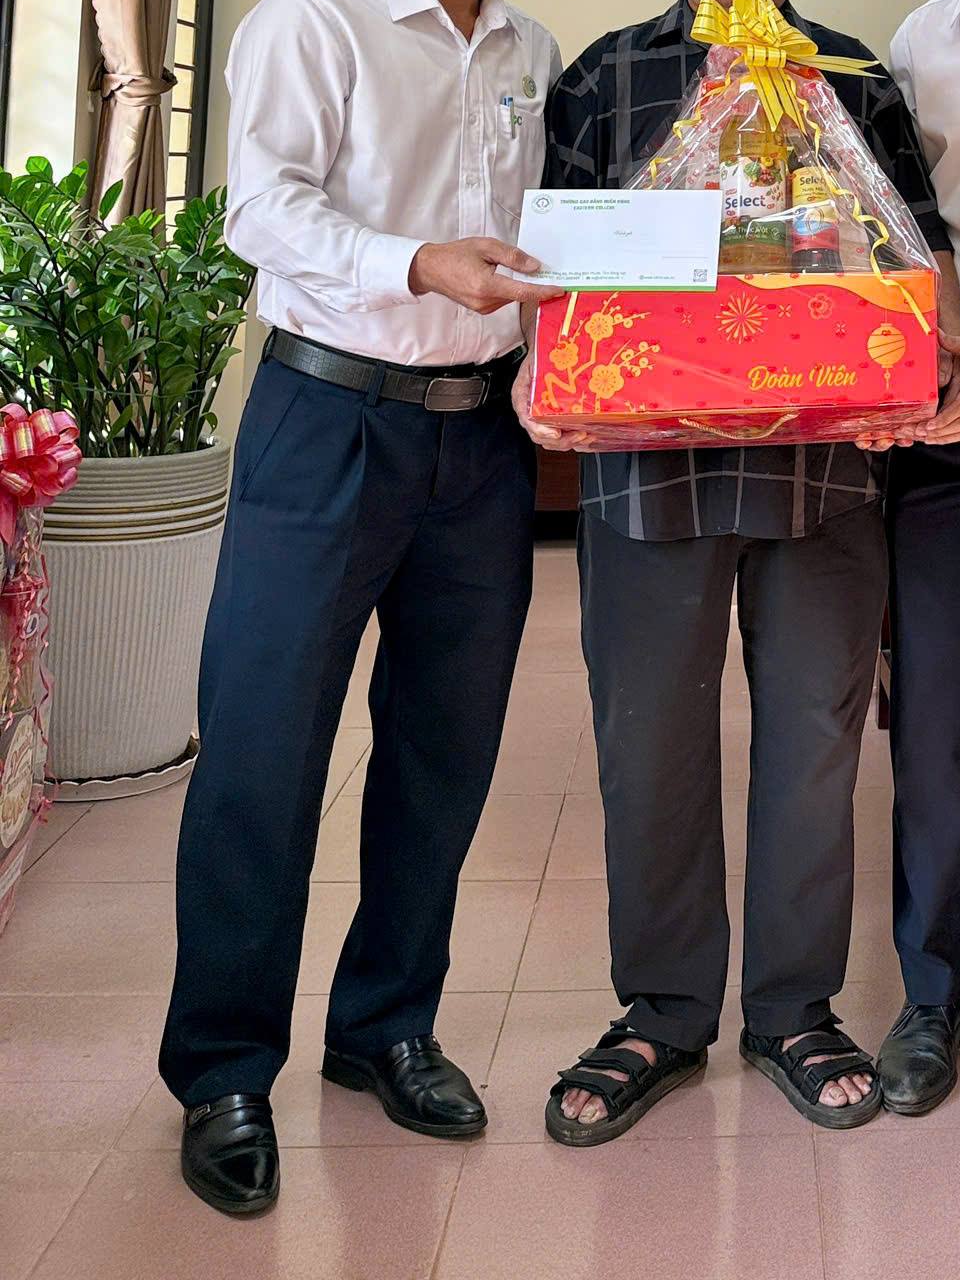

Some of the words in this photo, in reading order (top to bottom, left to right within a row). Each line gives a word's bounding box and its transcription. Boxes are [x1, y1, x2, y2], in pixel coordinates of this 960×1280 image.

[725, 194, 767, 210] Select
[747, 364, 804, 392] Đoàn
[808, 362, 858, 389] Viên
